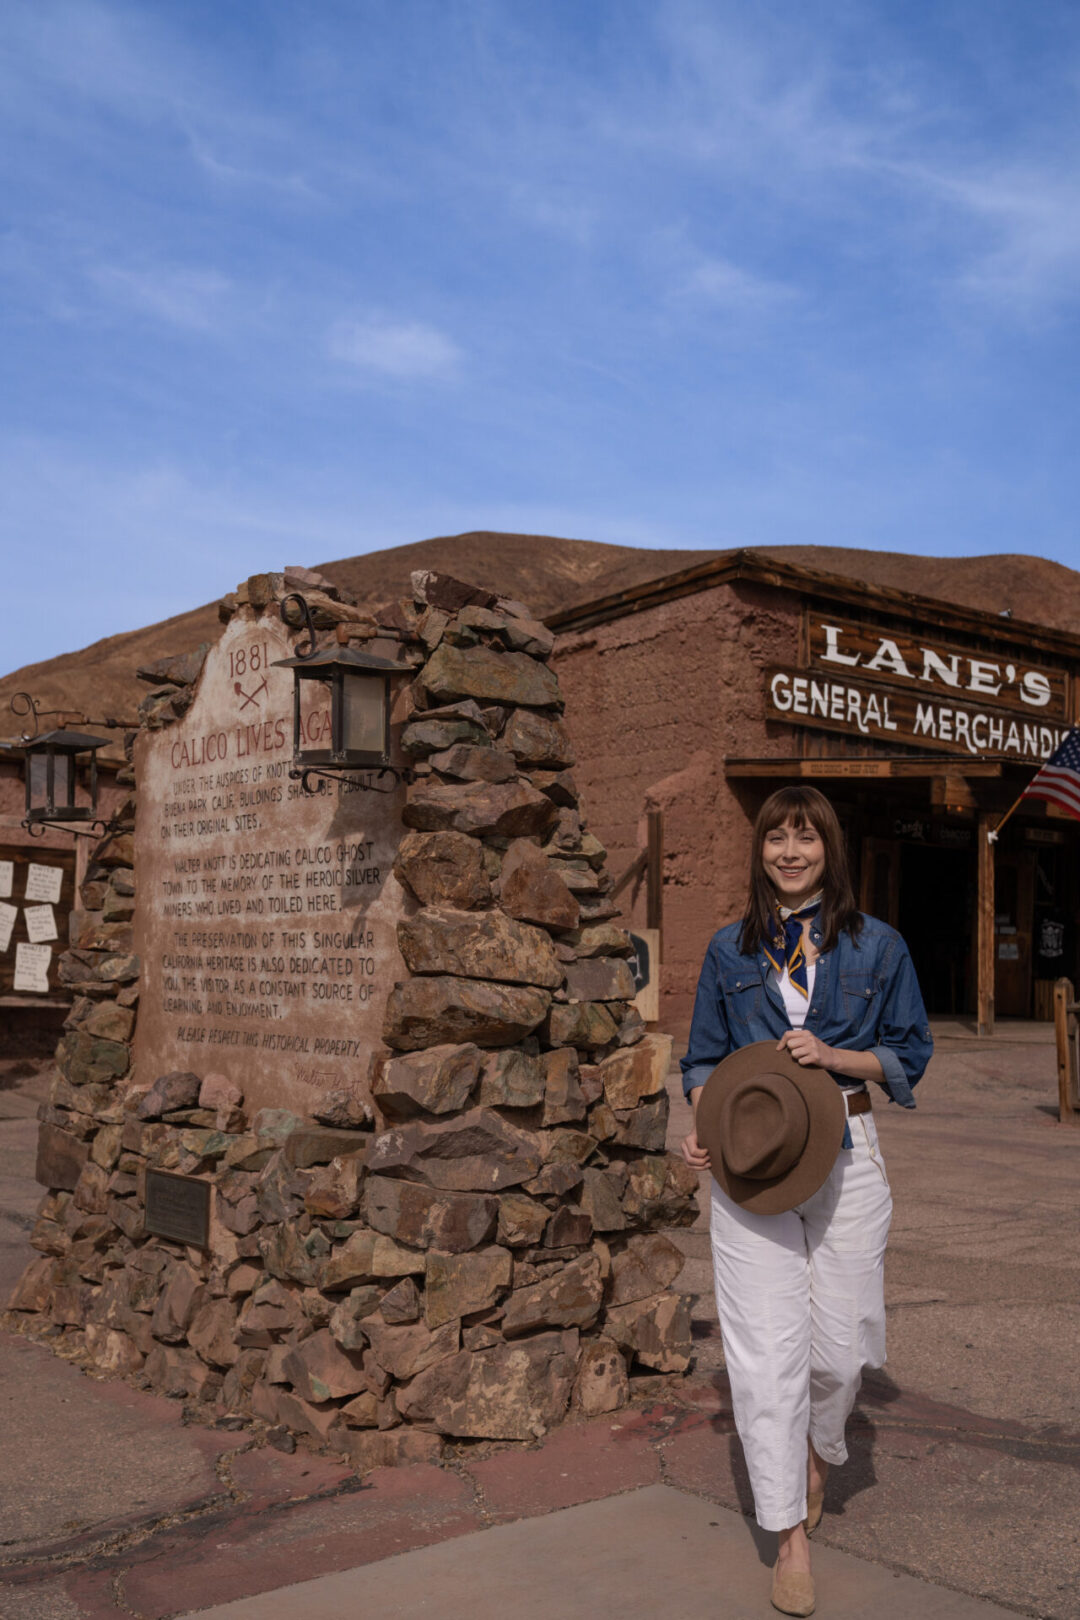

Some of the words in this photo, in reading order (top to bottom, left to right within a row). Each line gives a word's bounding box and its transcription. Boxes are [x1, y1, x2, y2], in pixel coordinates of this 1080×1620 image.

[230, 642, 268, 678] 1881
[820, 624, 1051, 706] LANE'S
[771, 673, 897, 733] GENERAL
[171, 732, 227, 769] CALICO
[237, 718, 286, 757] LIVES
[173, 777, 196, 796] UNDER
[199, 775, 214, 791] THE
[216, 768, 249, 788] AUSPICES
[252, 766, 262, 782] OF
[165, 802, 186, 818] BUENA
[189, 799, 207, 812] PARK
[240, 786, 282, 807] BUILDINGS
[161, 826, 171, 839] ON
[173, 821, 194, 837] THEIR
[197, 817, 230, 835] ORIGINAL
[235, 813, 262, 831] SITES.
[174, 858, 200, 873] WALTER
[204, 855, 226, 871] KNOTT
[229, 855, 236, 870] IS
[240, 850, 291, 869] DEDICATING
[295, 846, 331, 866] CALICO
[336, 842, 374, 862] GHOST
[162, 881, 183, 896] TOWN
[187, 879, 198, 894] TO
[201, 878, 216, 893] THE
[221, 876, 257, 892] MEMORY
[262, 874, 274, 890] OF
[280, 873, 300, 888] THE
[306, 870, 342, 887] HEROIC
[345, 867, 381, 886] SILVER
[163, 901, 192, 917] MINERS
[195, 901, 214, 915] WHO
[218, 899, 241, 915] LIVED
[246, 898, 264, 914] AND
[268, 896, 302, 913] TOILED
[307, 894, 342, 912] HERE.
[174, 932, 188, 947] THE
[192, 931, 257, 949] PRESERVATION
[262, 932, 274, 949] OF
[282, 931, 306, 949] THIS
[313, 931, 375, 950] SINGULAR
[162, 954, 204, 969] CALIFORNIA
[206, 956, 244, 972] HERITAGE
[247, 956, 257, 972] IS
[260, 956, 285, 973] ALSO
[289, 957, 353, 976] DEDICATED
[358, 957, 375, 976] TO
[164, 976, 178, 991] YOU
[182, 976, 197, 992] THE
[201, 978, 229, 993] VISITOR
[234, 979, 245, 995] AS
[249, 980, 256, 993] A
[259, 980, 306, 997] CONSTANT
[312, 982, 353, 1000] SOURCE
[359, 984, 375, 1001] OF
[163, 998, 202, 1014] LEARNING
[207, 1000, 223, 1015] AND
[226, 1001, 282, 1019] ENJOYMENT.
[177, 1026, 206, 1042] PLEASE
[208, 1028, 240, 1045] RESPECT
[243, 1031, 259, 1047] THIS
[262, 1033, 310, 1053] HISTORICAL
[314, 1037, 360, 1058] PROPERTY.
